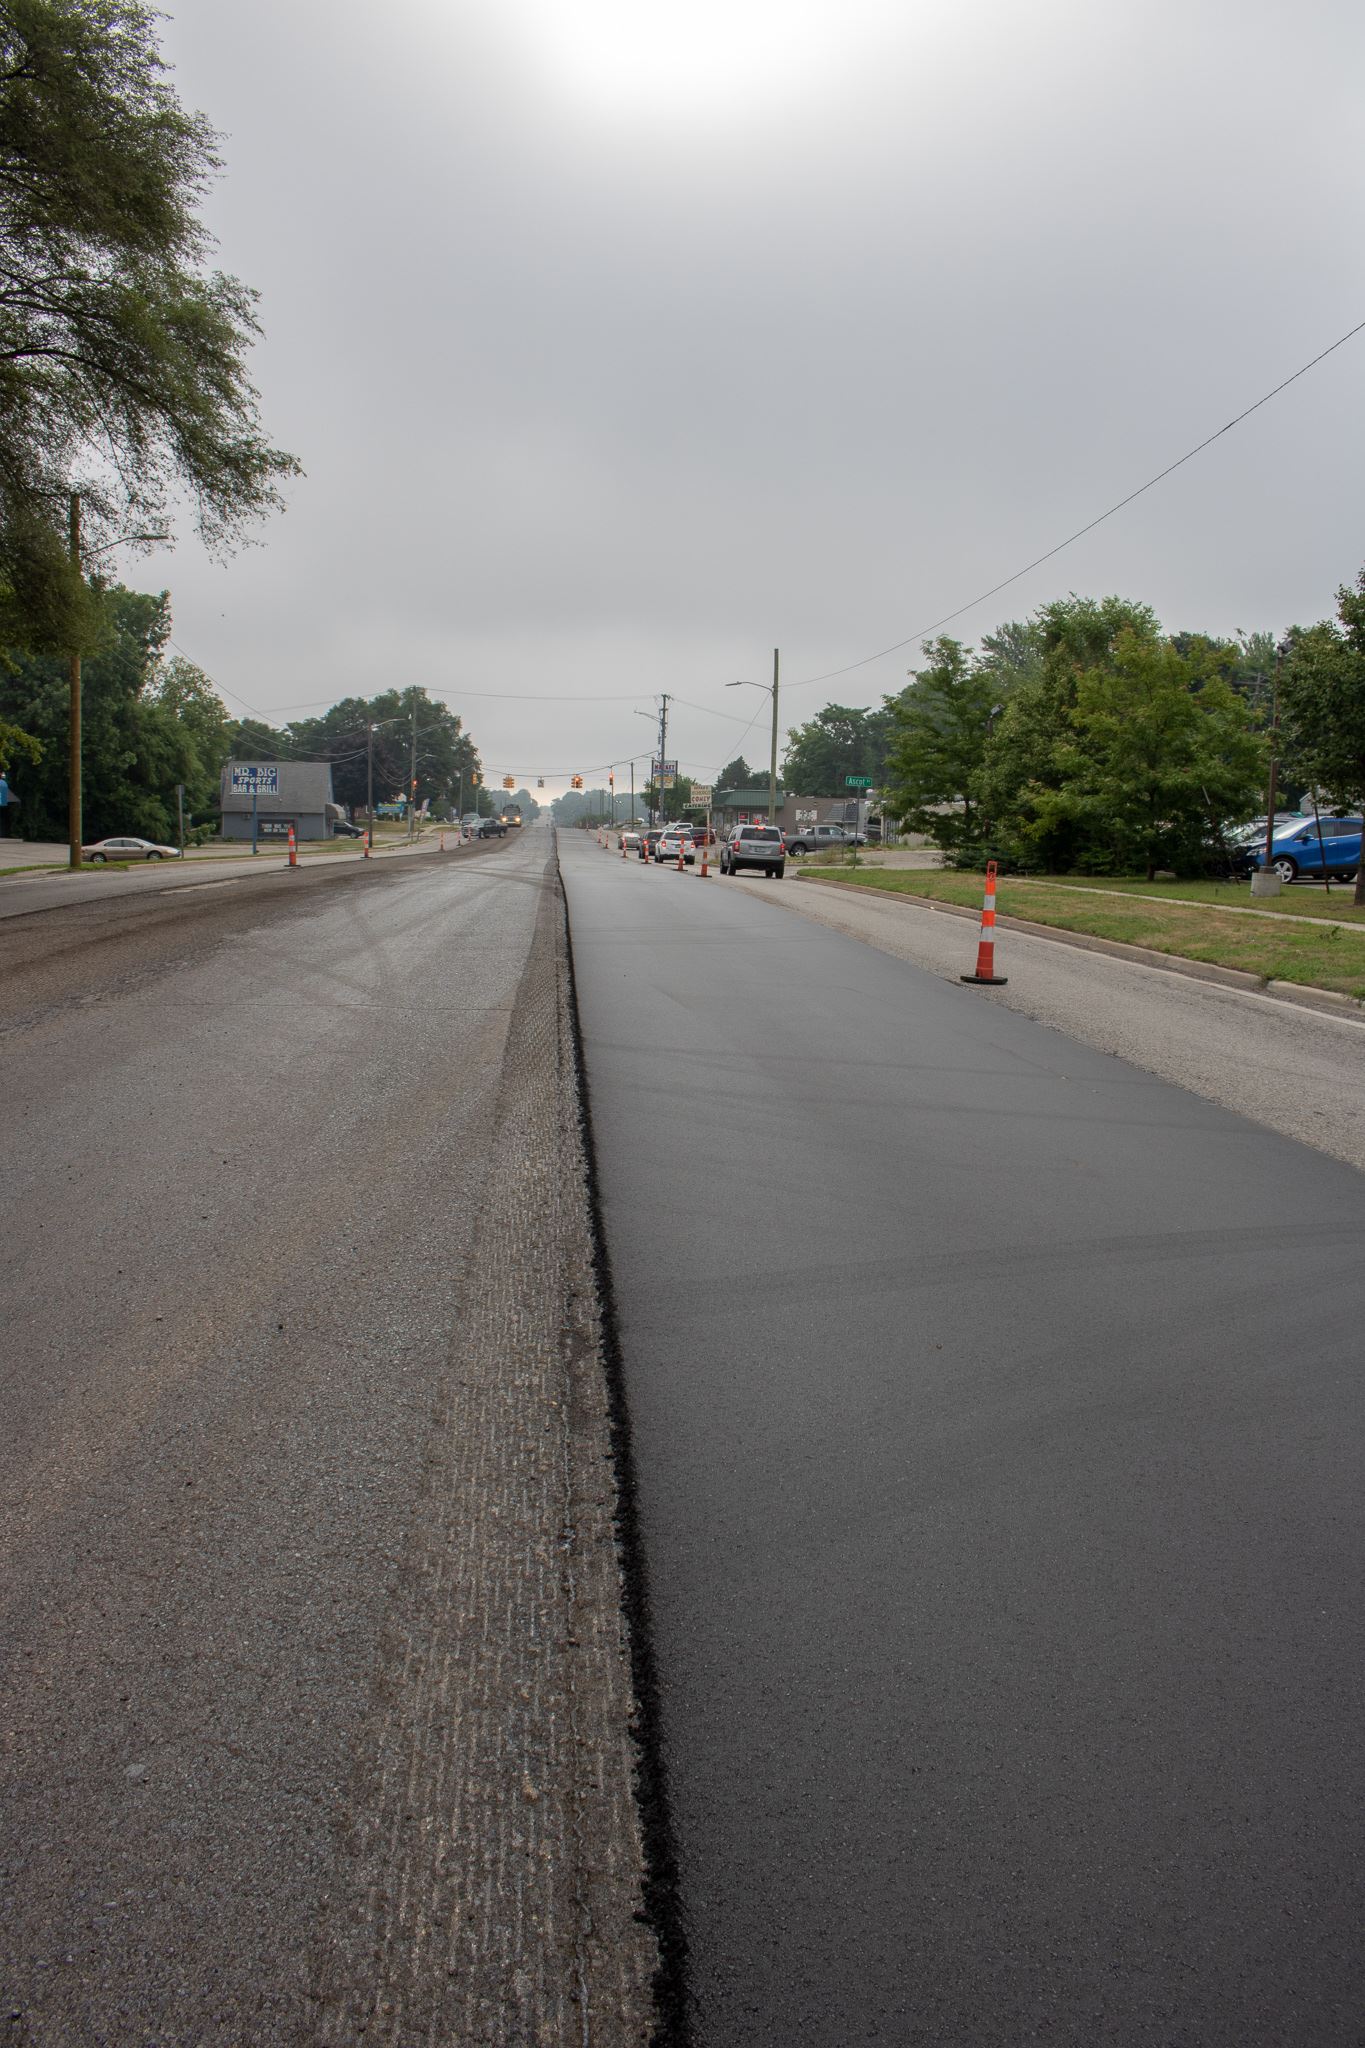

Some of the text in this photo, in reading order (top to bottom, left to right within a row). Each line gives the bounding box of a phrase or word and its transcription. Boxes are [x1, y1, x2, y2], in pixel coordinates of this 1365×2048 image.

[234, 767, 276, 777] MR. BIG
[848, 777, 865, 785] Ascot
[233, 784, 276, 794] BAR & GRILL
